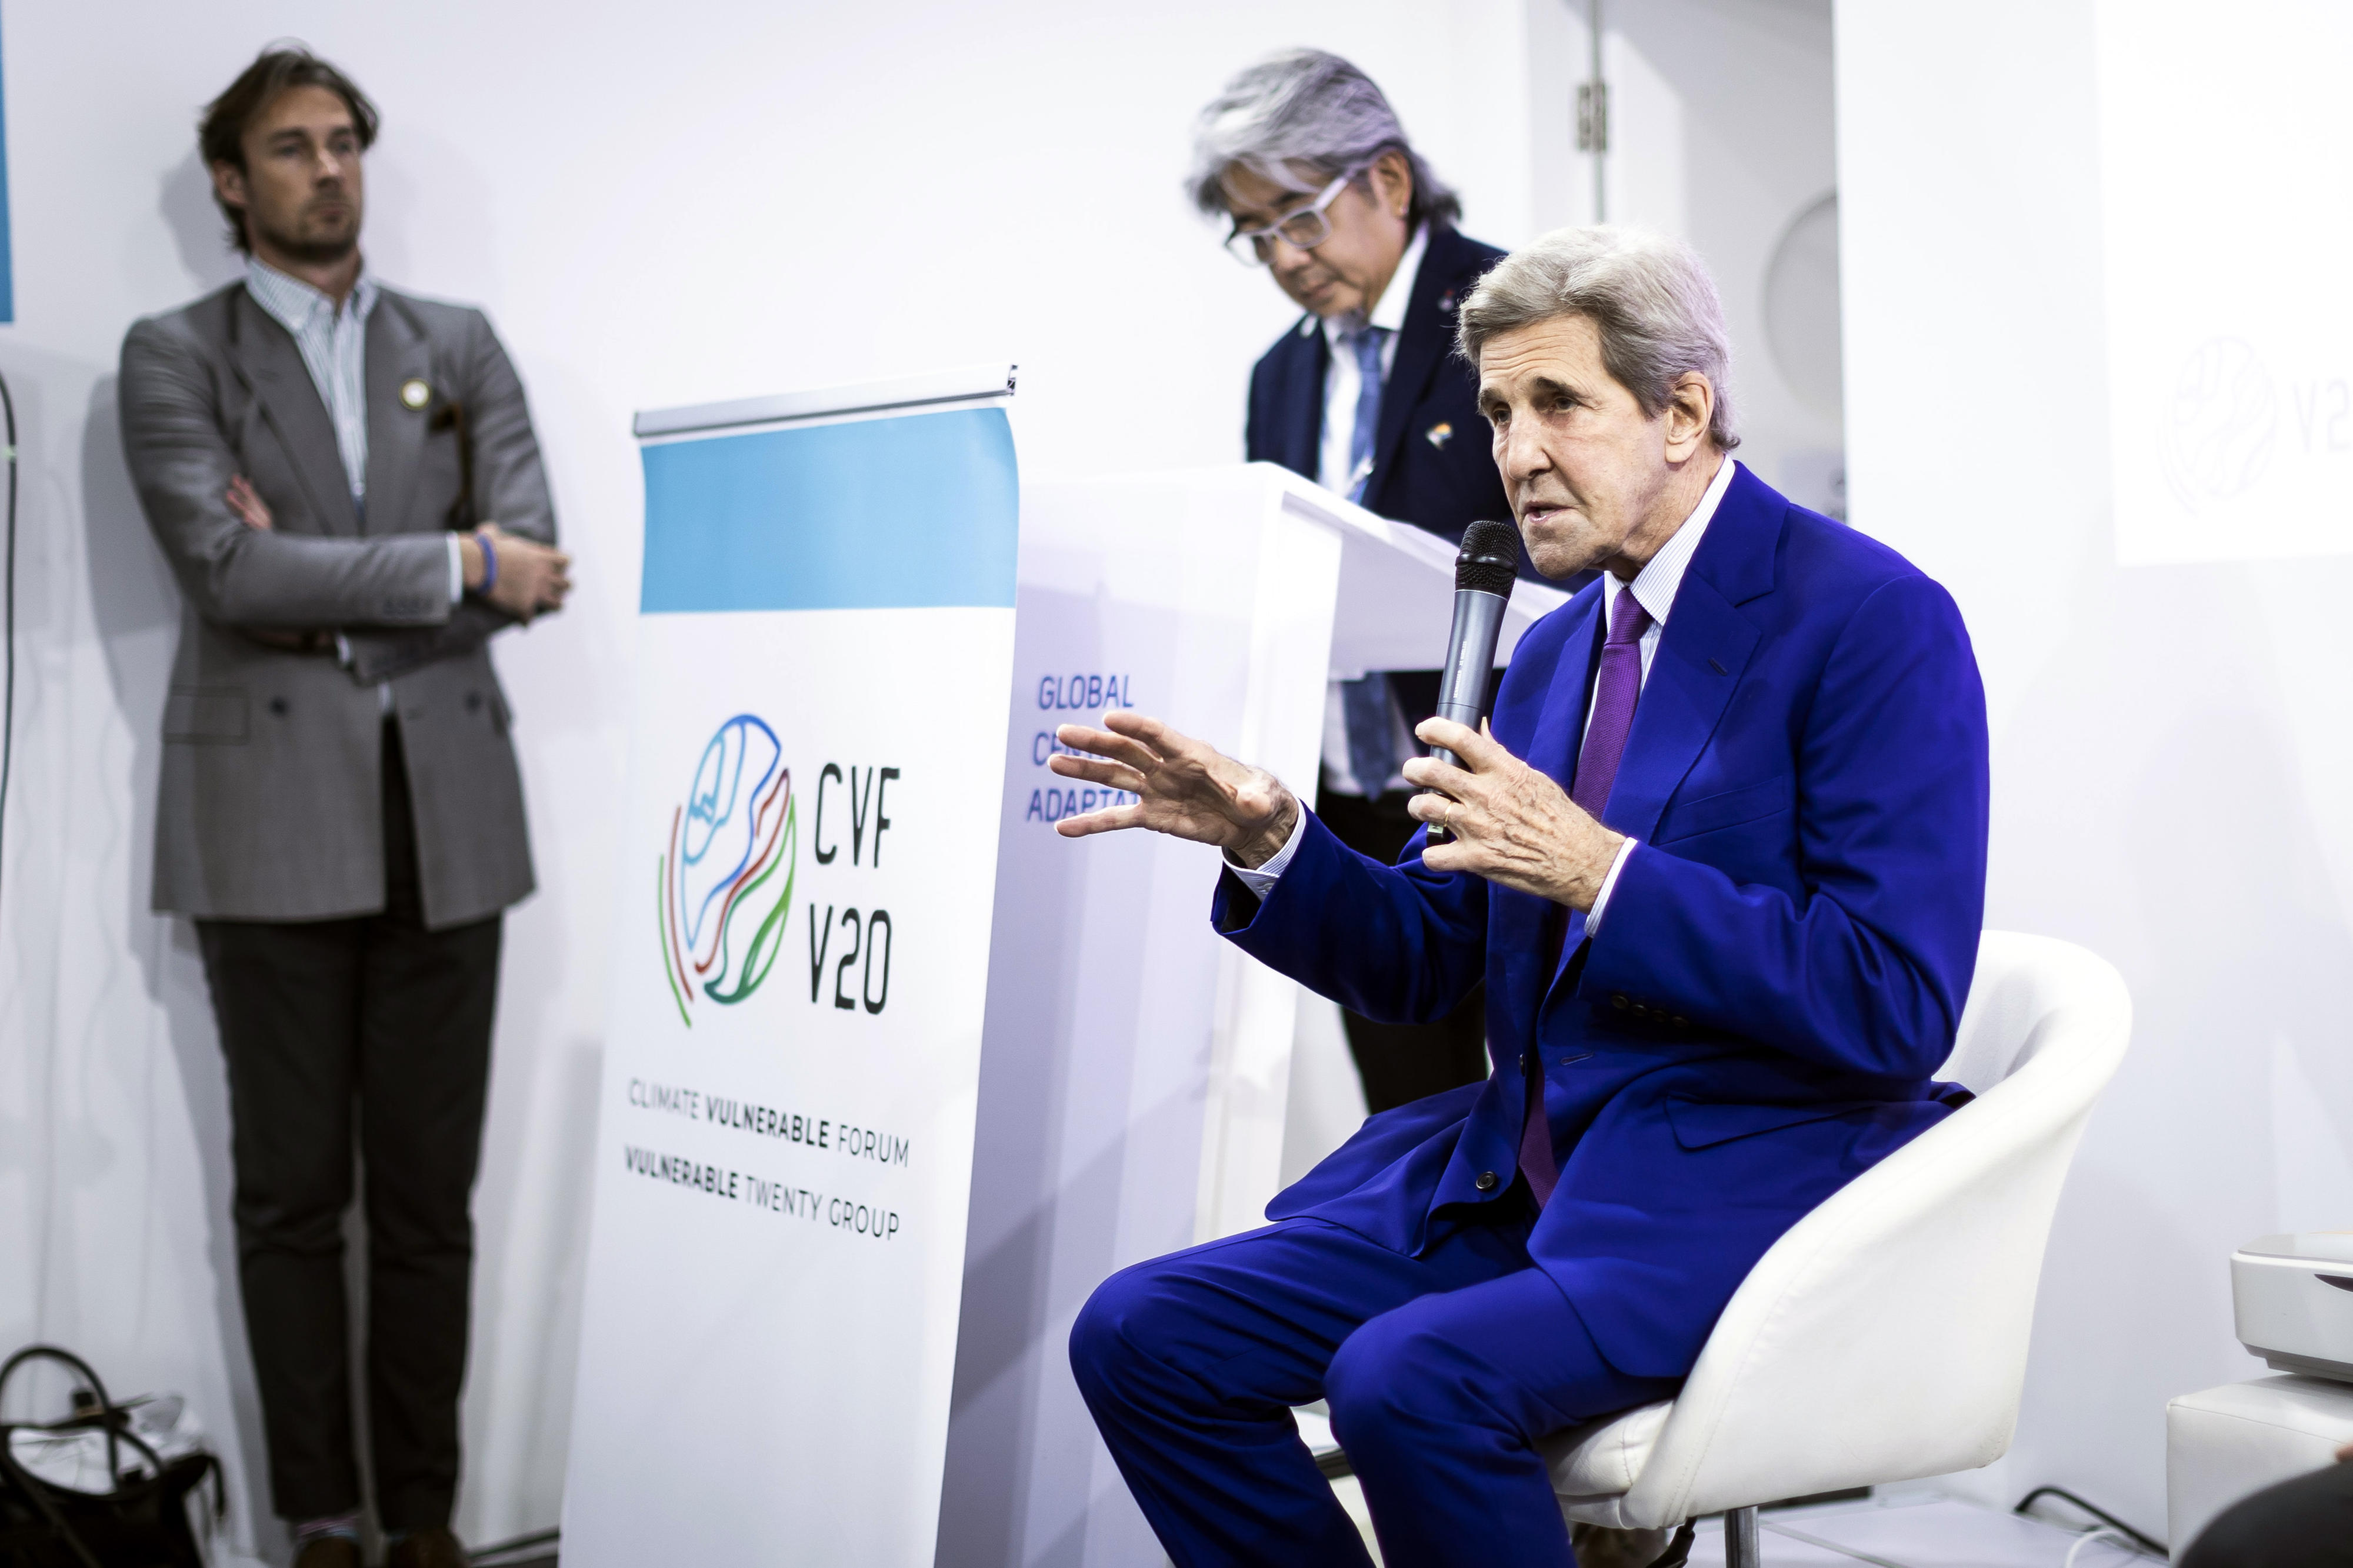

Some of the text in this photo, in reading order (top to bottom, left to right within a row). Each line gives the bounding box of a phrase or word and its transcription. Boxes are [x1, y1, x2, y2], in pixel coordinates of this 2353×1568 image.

[1038, 674, 1134, 709] GLOBAL
[815, 763, 900, 869] CVF
[810, 903, 892, 1015] V20
[628, 1077, 909, 1168] CLIMATE VULNERABLE FORUM
[624, 1145, 899, 1241] VULNERABLE TWENTY GROUP
